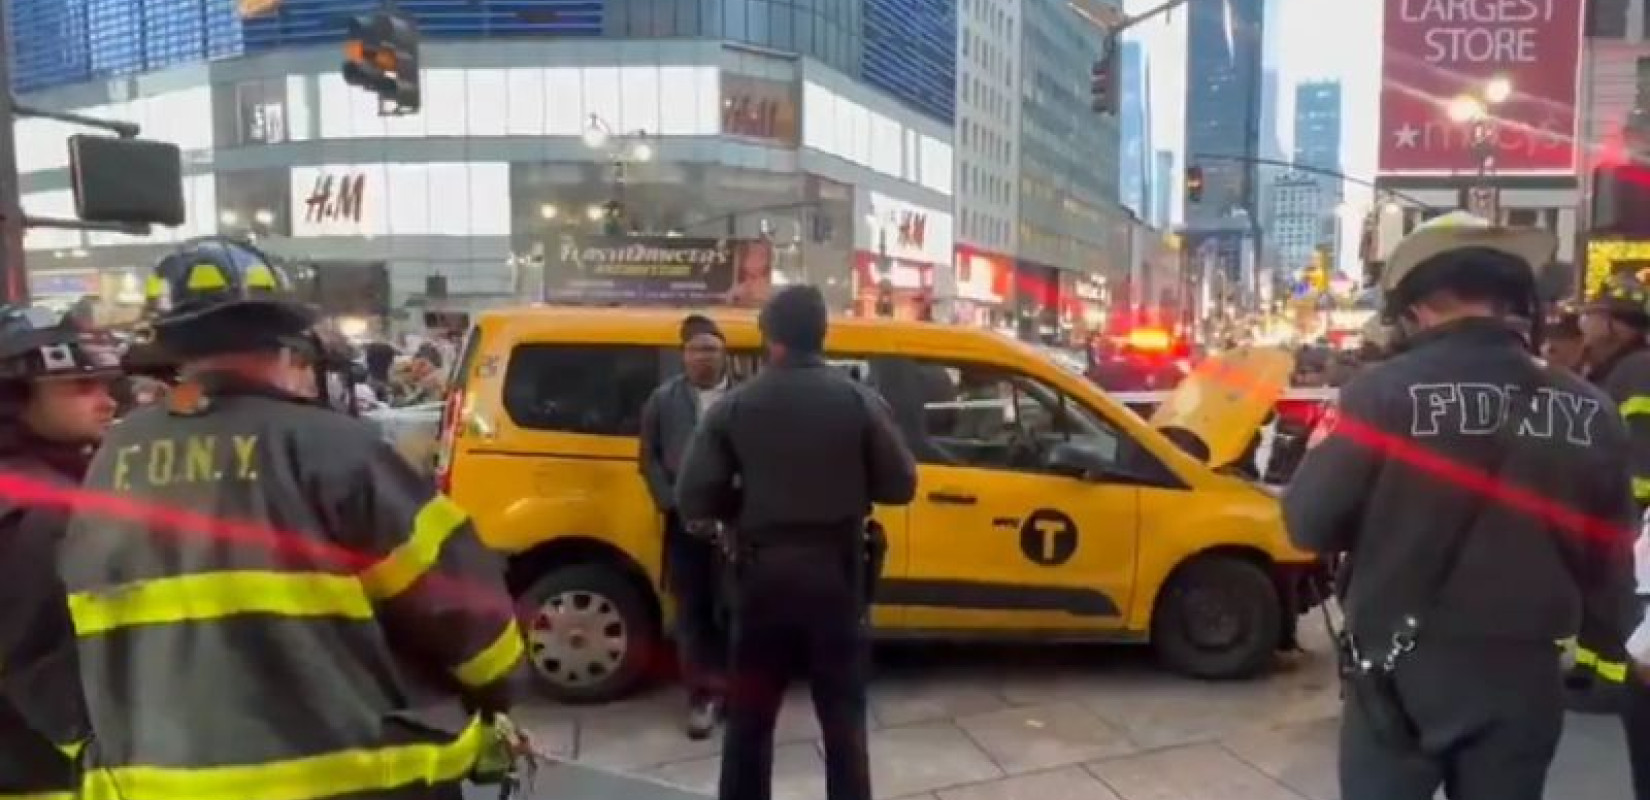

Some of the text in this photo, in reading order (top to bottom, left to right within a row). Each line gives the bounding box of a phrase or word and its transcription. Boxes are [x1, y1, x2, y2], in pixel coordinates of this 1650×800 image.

[1401, 0, 1553, 23] LARGEST
[1424, 27, 1536, 62] STORE
[305, 173, 365, 223] H&M
[1409, 376, 1599, 445] FDNY
[1034, 519, 1066, 559] T
